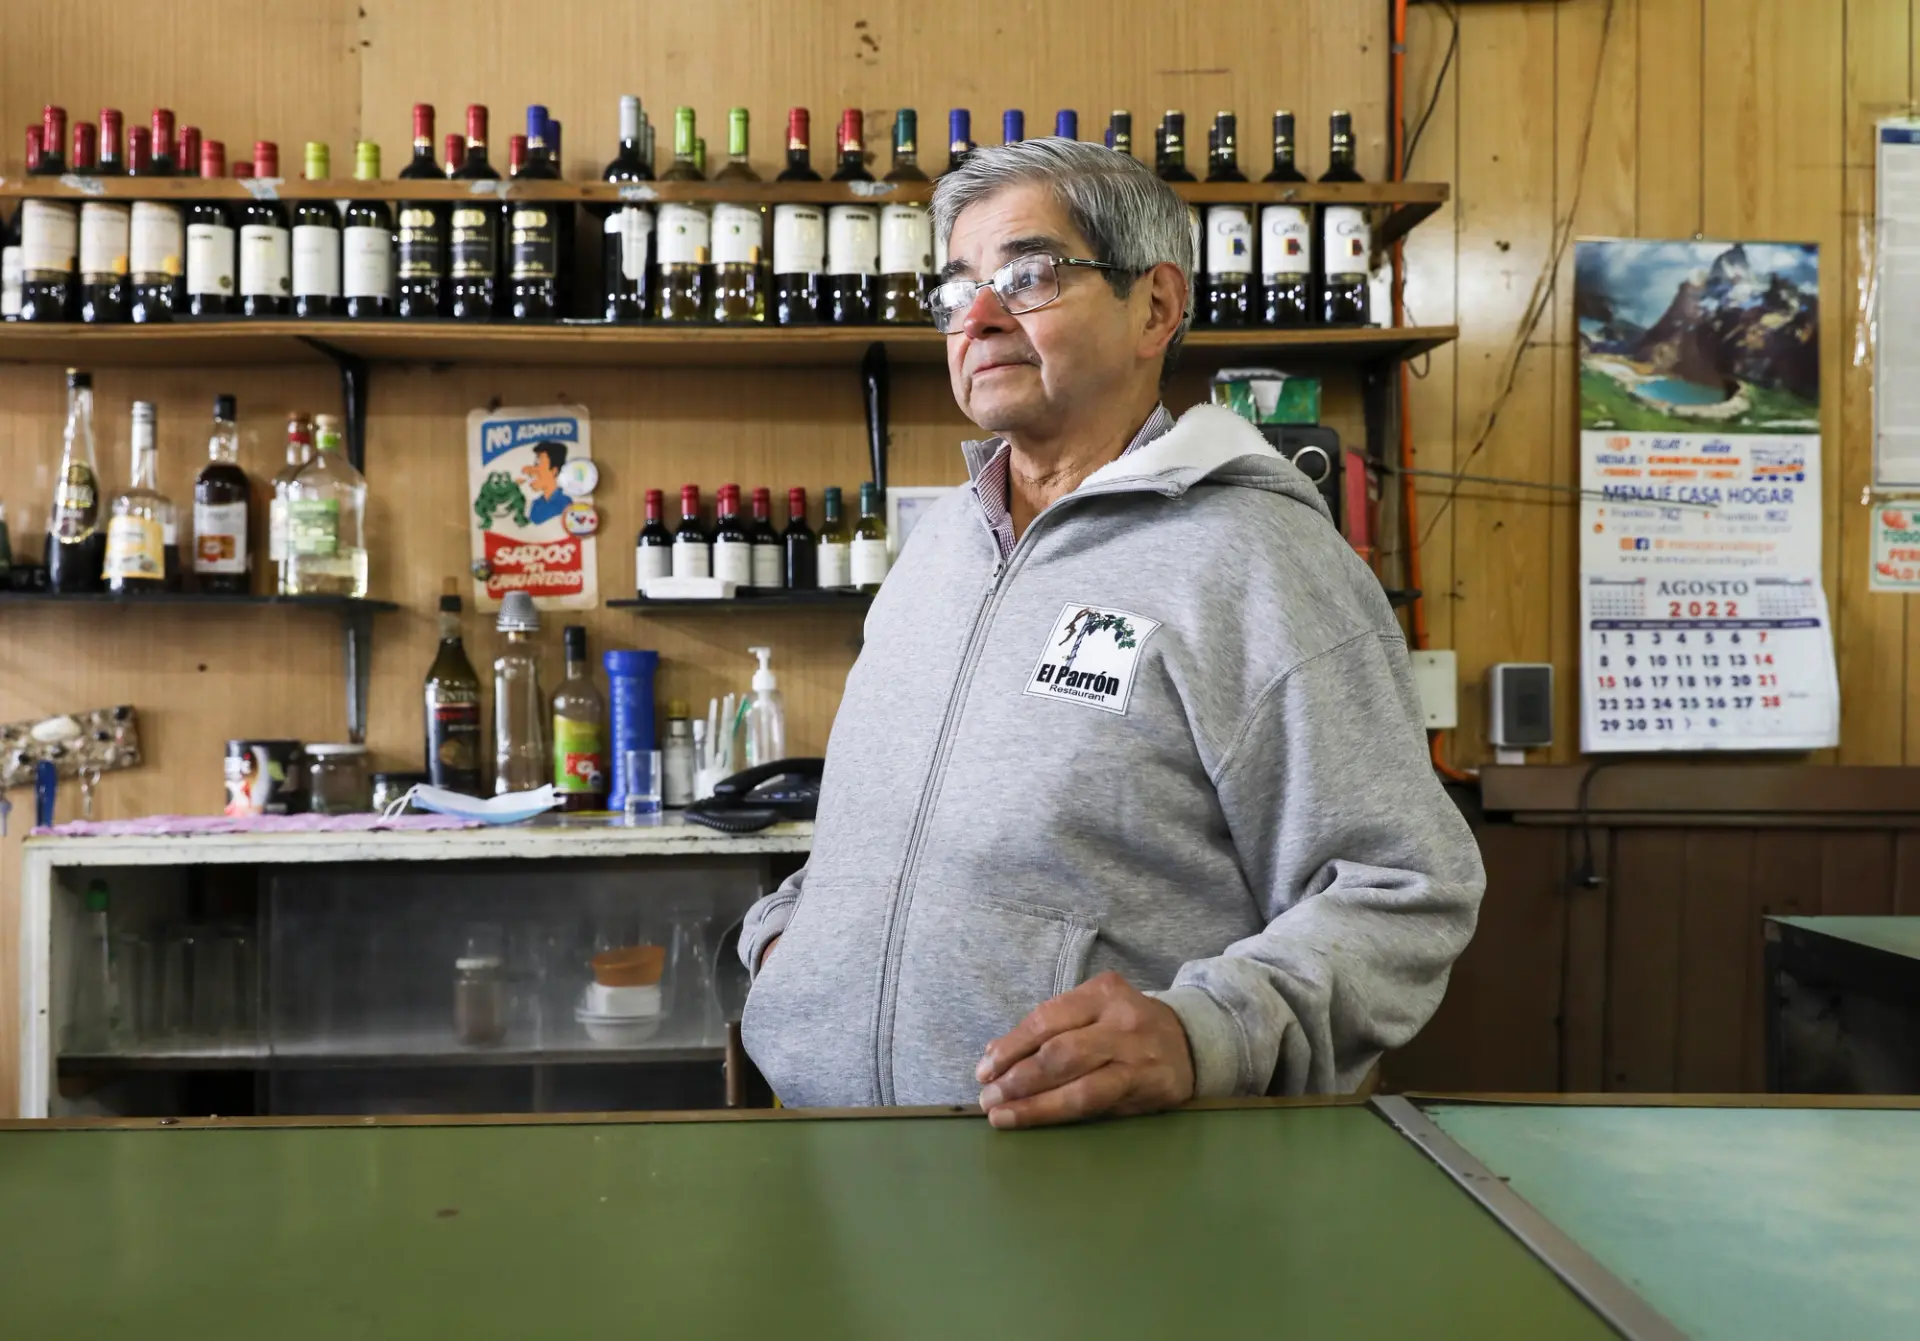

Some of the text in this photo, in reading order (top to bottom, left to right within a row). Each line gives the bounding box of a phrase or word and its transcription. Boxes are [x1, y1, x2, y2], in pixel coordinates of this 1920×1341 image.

[486, 422, 573, 453] NO ADMITO
[1678, 487, 1721, 504] CASA
[1727, 488, 1794, 505] HOGAR
[1657, 581, 1749, 596] AGOSTO
[1669, 602, 1737, 618] 2022
[1601, 631, 1768, 645] 1 2 3 4 5 6 7
[1601, 655, 1772, 667] 8 9 10 11 12 13 14
[1036, 663, 1120, 696] El Parrón
[1599, 675, 1775, 688] 15 16 17 18 19 20 21
[1049, 684, 1105, 702] Restaurant
[1599, 696, 1780, 710] 22 23 24 25 26 27 28
[1601, 718, 1672, 731] 29 30 31
